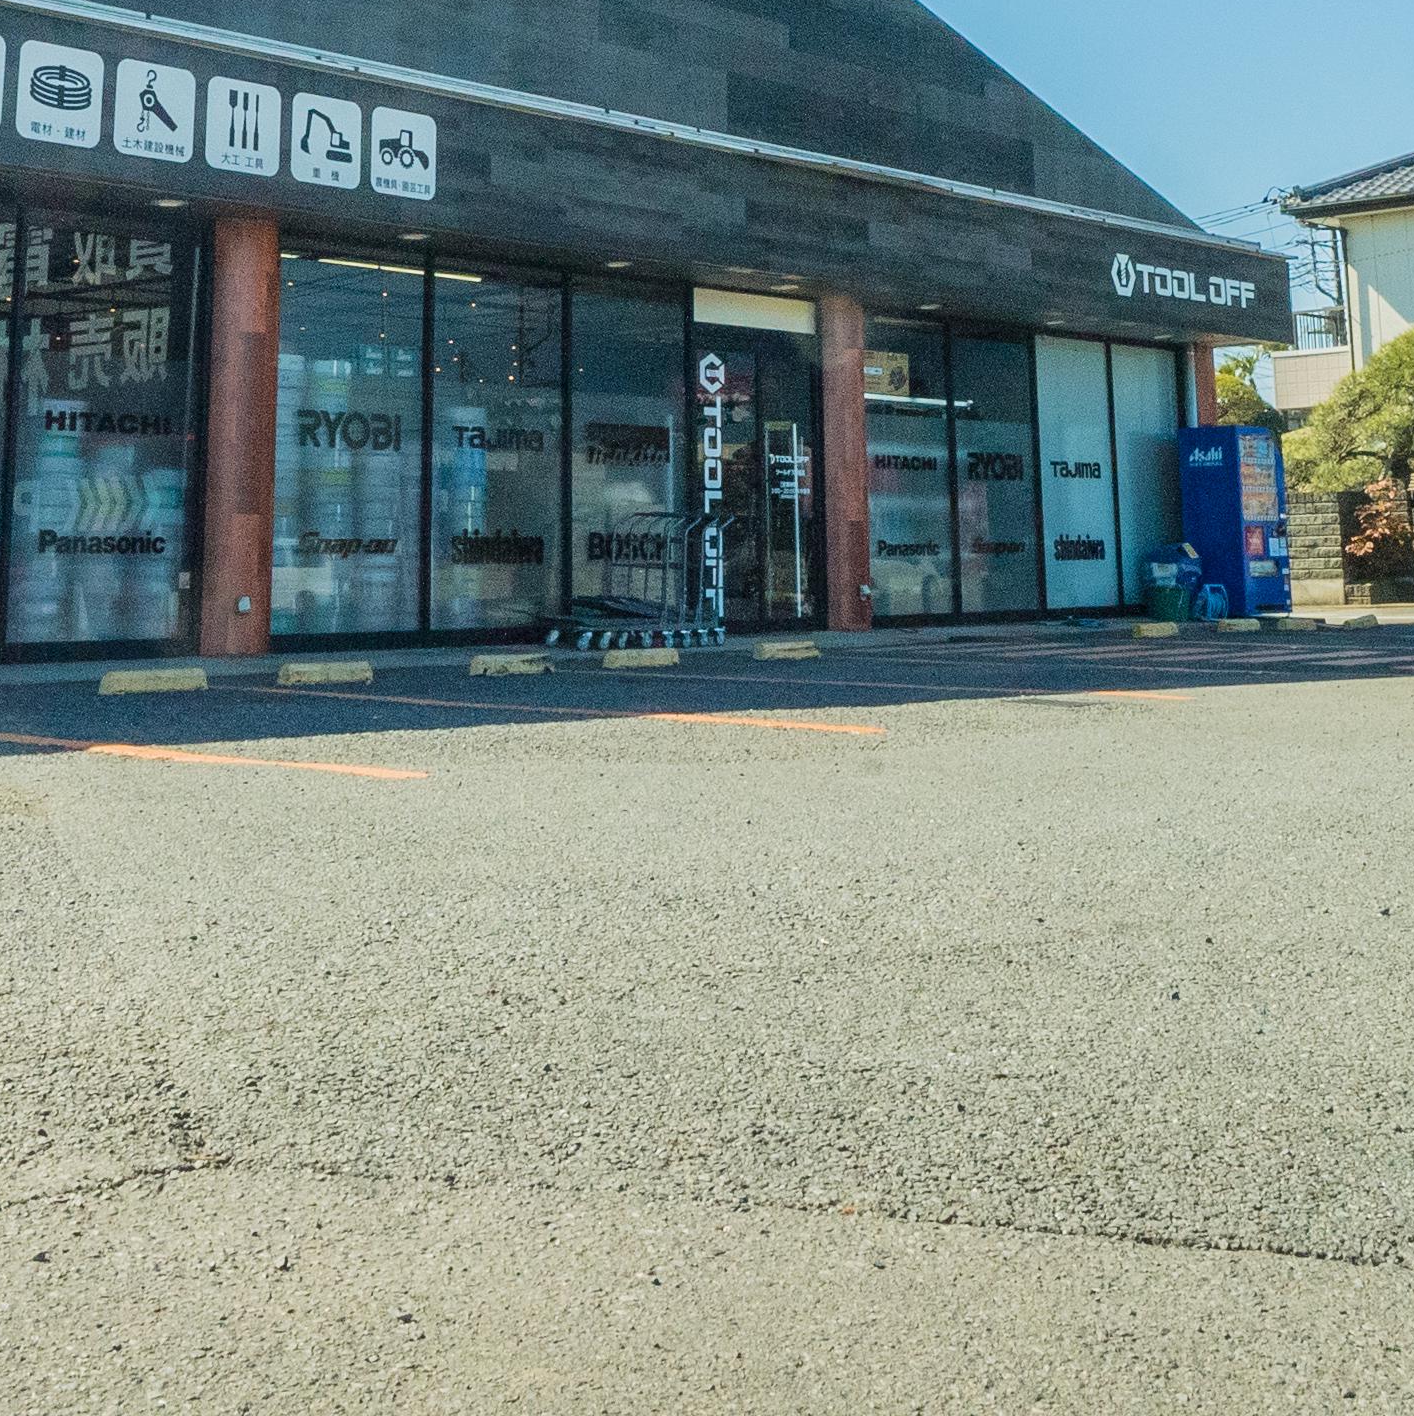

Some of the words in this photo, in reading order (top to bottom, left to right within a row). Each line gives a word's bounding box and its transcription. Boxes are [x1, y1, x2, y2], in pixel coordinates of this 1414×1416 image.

[1137, 264, 1205, 301] TOOL
[1208, 277, 1255, 309] OFF
[44, 410, 173, 436] HITACHI
[297, 410, 401, 451] RYOBI
[702, 396, 724, 514] TOOL
[967, 452, 1024, 481] RYOBI
[1189, 446, 1223, 462] Asahi
[1050, 460, 1102, 480] Tajima
[37, 529, 166, 556] Panasonic
